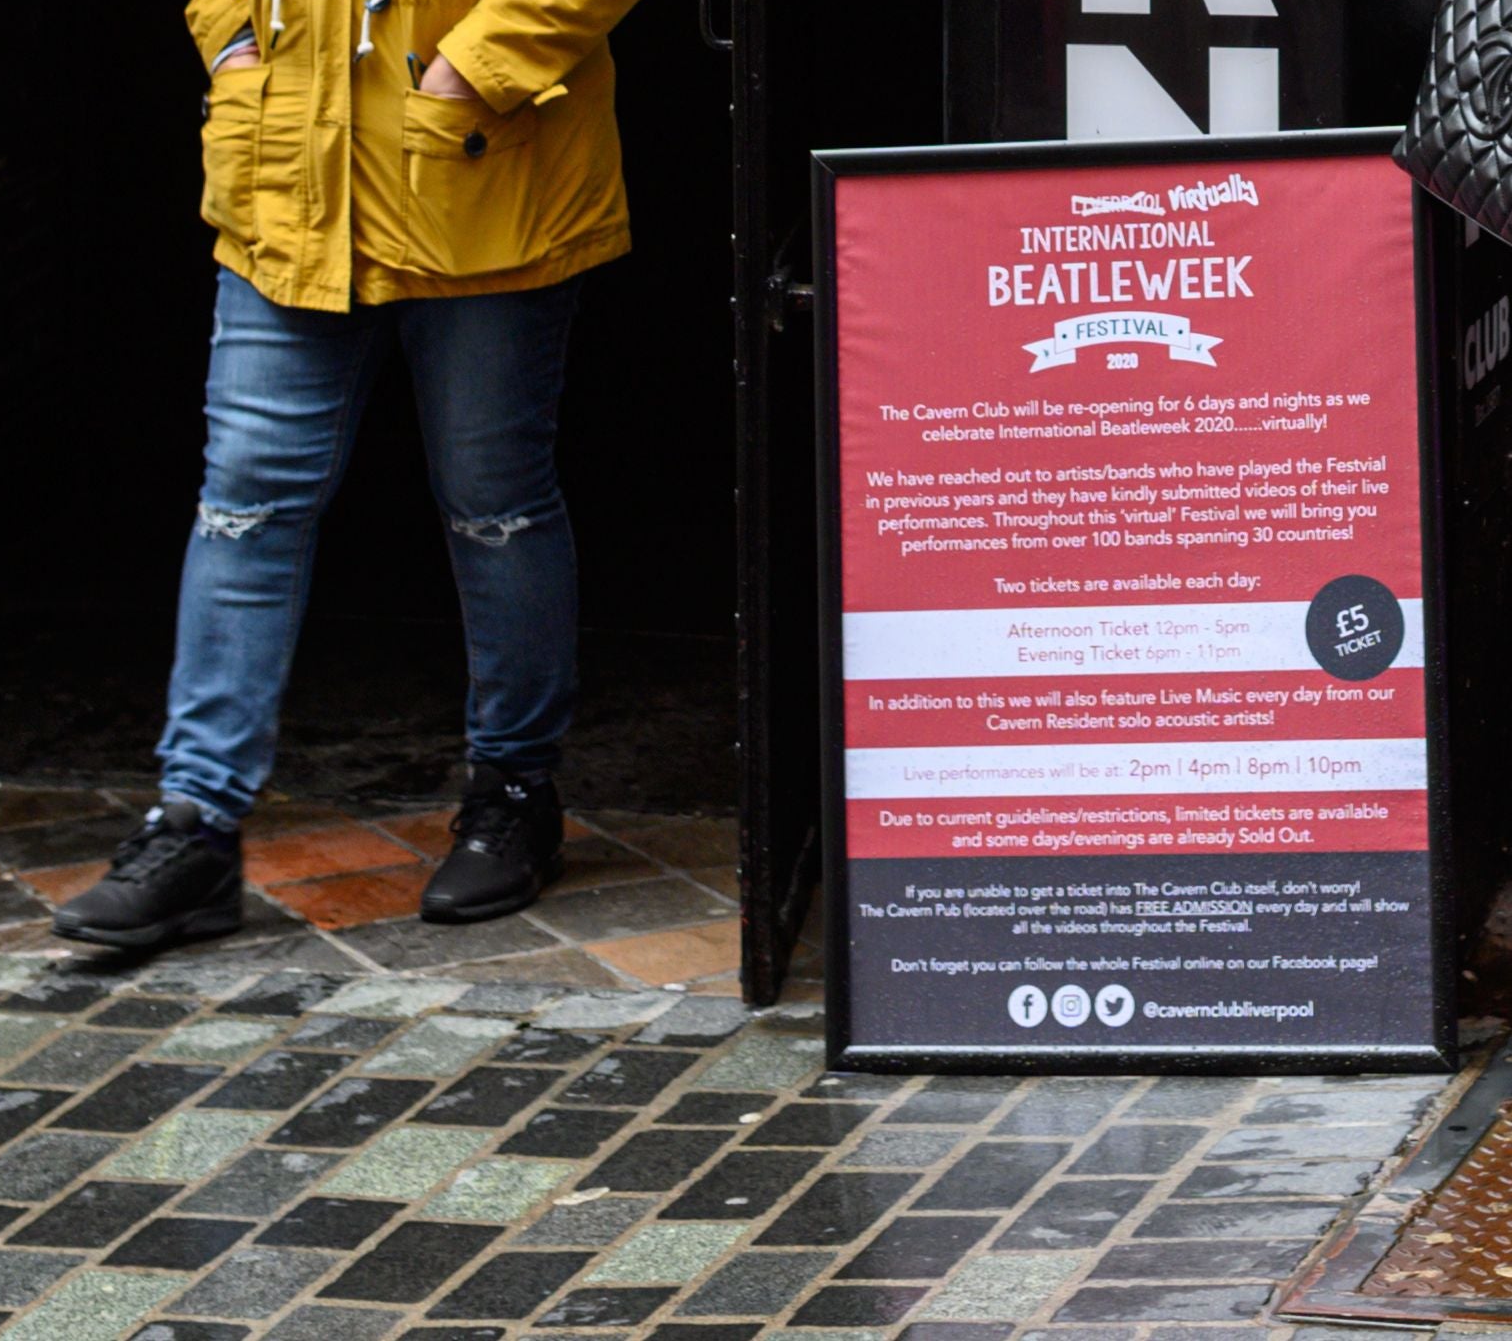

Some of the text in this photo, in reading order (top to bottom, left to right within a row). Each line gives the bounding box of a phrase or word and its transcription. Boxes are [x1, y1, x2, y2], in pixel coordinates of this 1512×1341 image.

[1020, 220, 1215, 254] INTERNATIONAL
[988, 255, 1254, 307] BEATLEWEEK
[1075, 319, 1168, 340] FESTIVAL
[1465, 294, 1509, 391] CLUB
[1106, 352, 1139, 370] 2020
[879, 391, 1370, 421] The Cavern Club will be re-opening for 6 days and nights as we
[1335, 604, 1369, 639] £5
[1333, 629, 1382, 658] TICKET
[1142, 1001, 1314, 1022] @cavernclubliverpool
